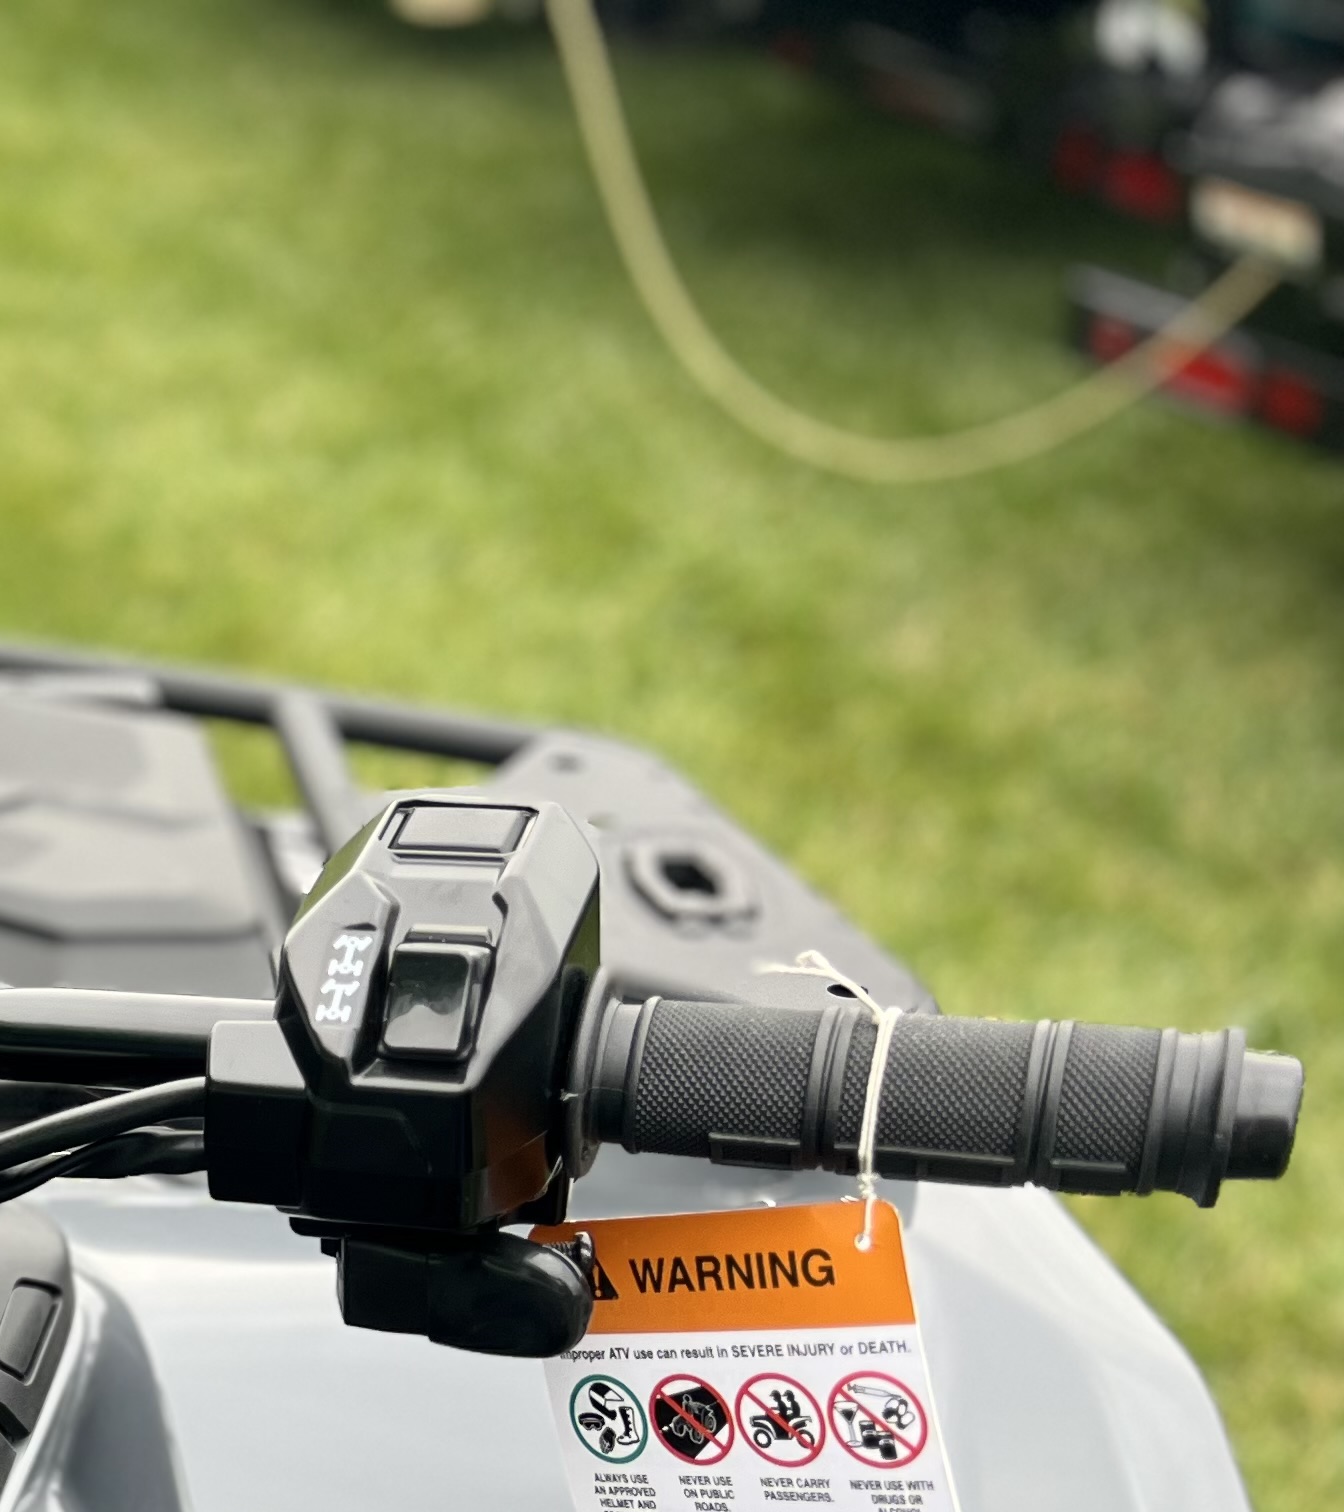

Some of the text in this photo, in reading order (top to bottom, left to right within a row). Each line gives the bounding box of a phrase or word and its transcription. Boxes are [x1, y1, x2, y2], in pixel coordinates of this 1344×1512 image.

[628, 1248, 835, 1294] WARNING
[609, 1348, 629, 1359] ATV
[634, 1349, 654, 1359] use
[657, 1348, 677, 1359] can
[681, 1346, 714, 1359] result
[717, 1346, 728, 1358] in
[732, 1344, 784, 1357] SEVERE
[788, 1343, 835, 1356] INJURY
[841, 1343, 853, 1356] or
[859, 1340, 911, 1354] DEATH.
[595, 1473, 649, 1484] ALWAYS USE
[679, 1475, 733, 1486] NEVER USE
[760, 1477, 830, 1489] NEVER CARRY
[849, 1480, 934, 1491] NEVER USE WITH
[595, 1486, 656, 1497] AN APPROVED
[684, 1489, 735, 1499] ON PUBLIC
[600, 1499, 656, 1509] HELMET AND
